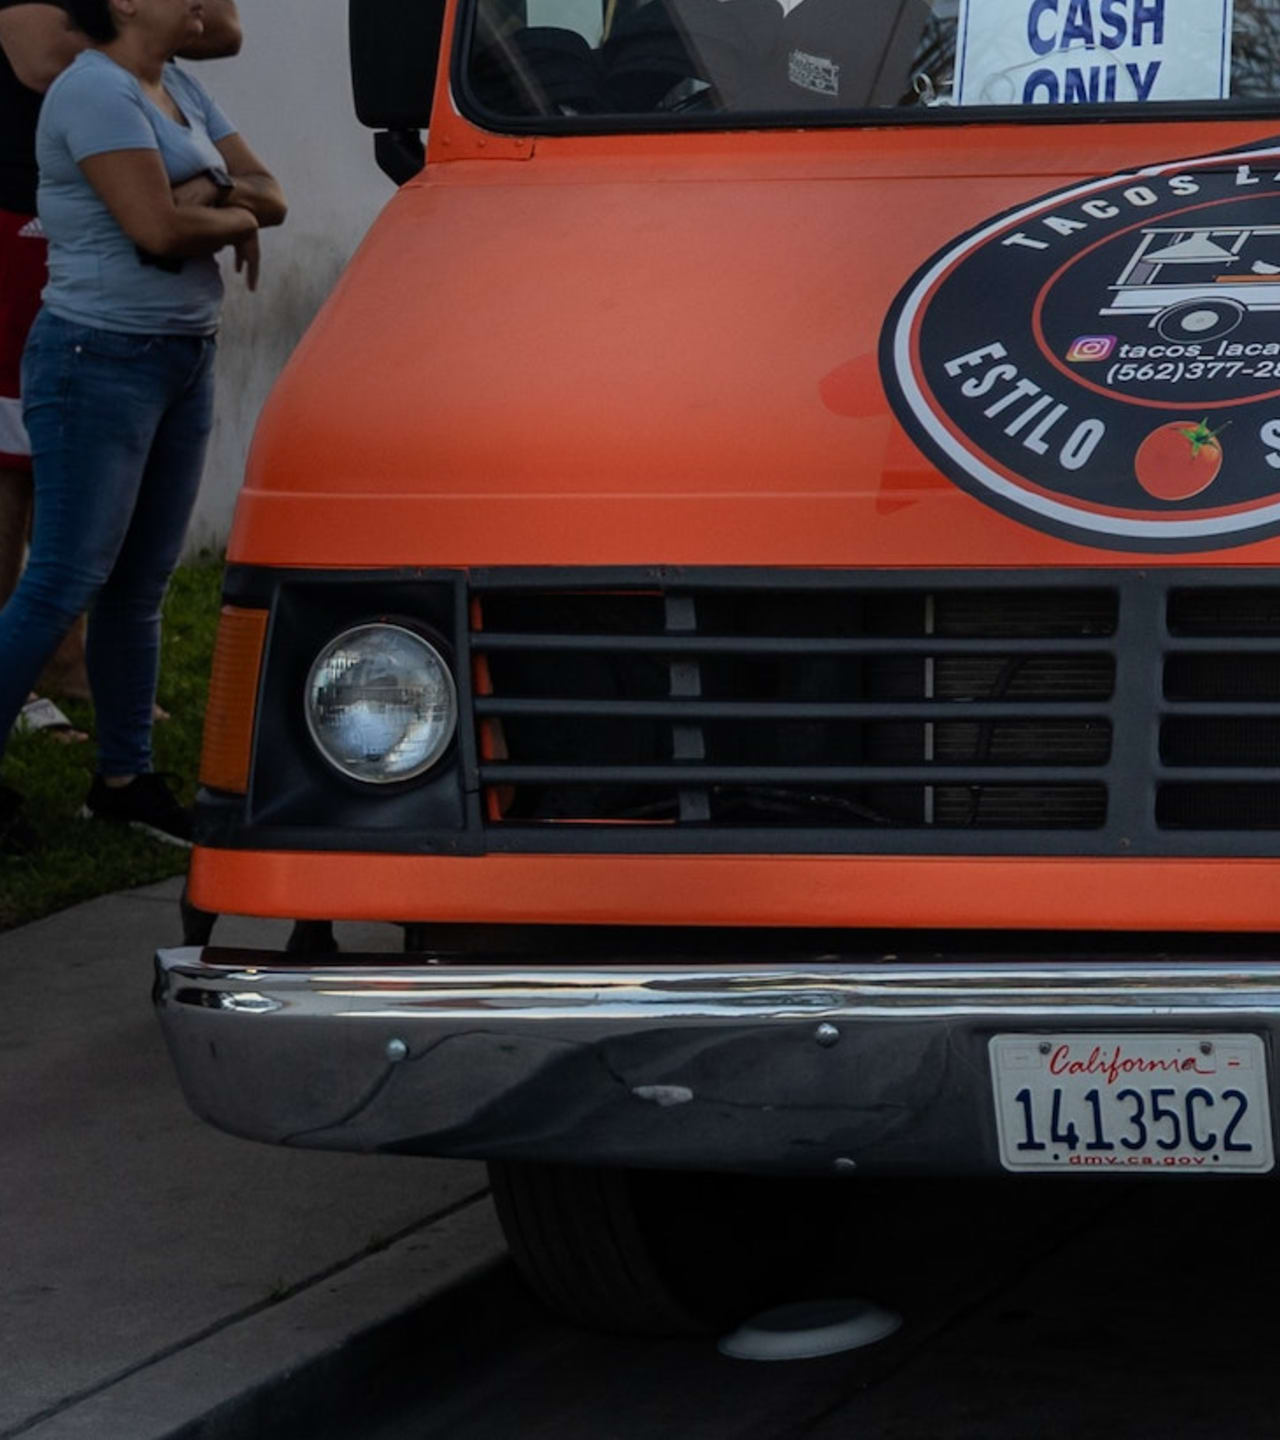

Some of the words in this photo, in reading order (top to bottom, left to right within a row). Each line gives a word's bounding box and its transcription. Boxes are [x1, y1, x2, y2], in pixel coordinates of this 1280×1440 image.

[1001, 174, 1201, 250] TACOS
[943, 340, 1106, 471] ESTILO
[1049, 1043, 1216, 1085] California
[1014, 1087, 1253, 1152] 14135C2
[1068, 1153, 1207, 1167] dmv.ca.gov
